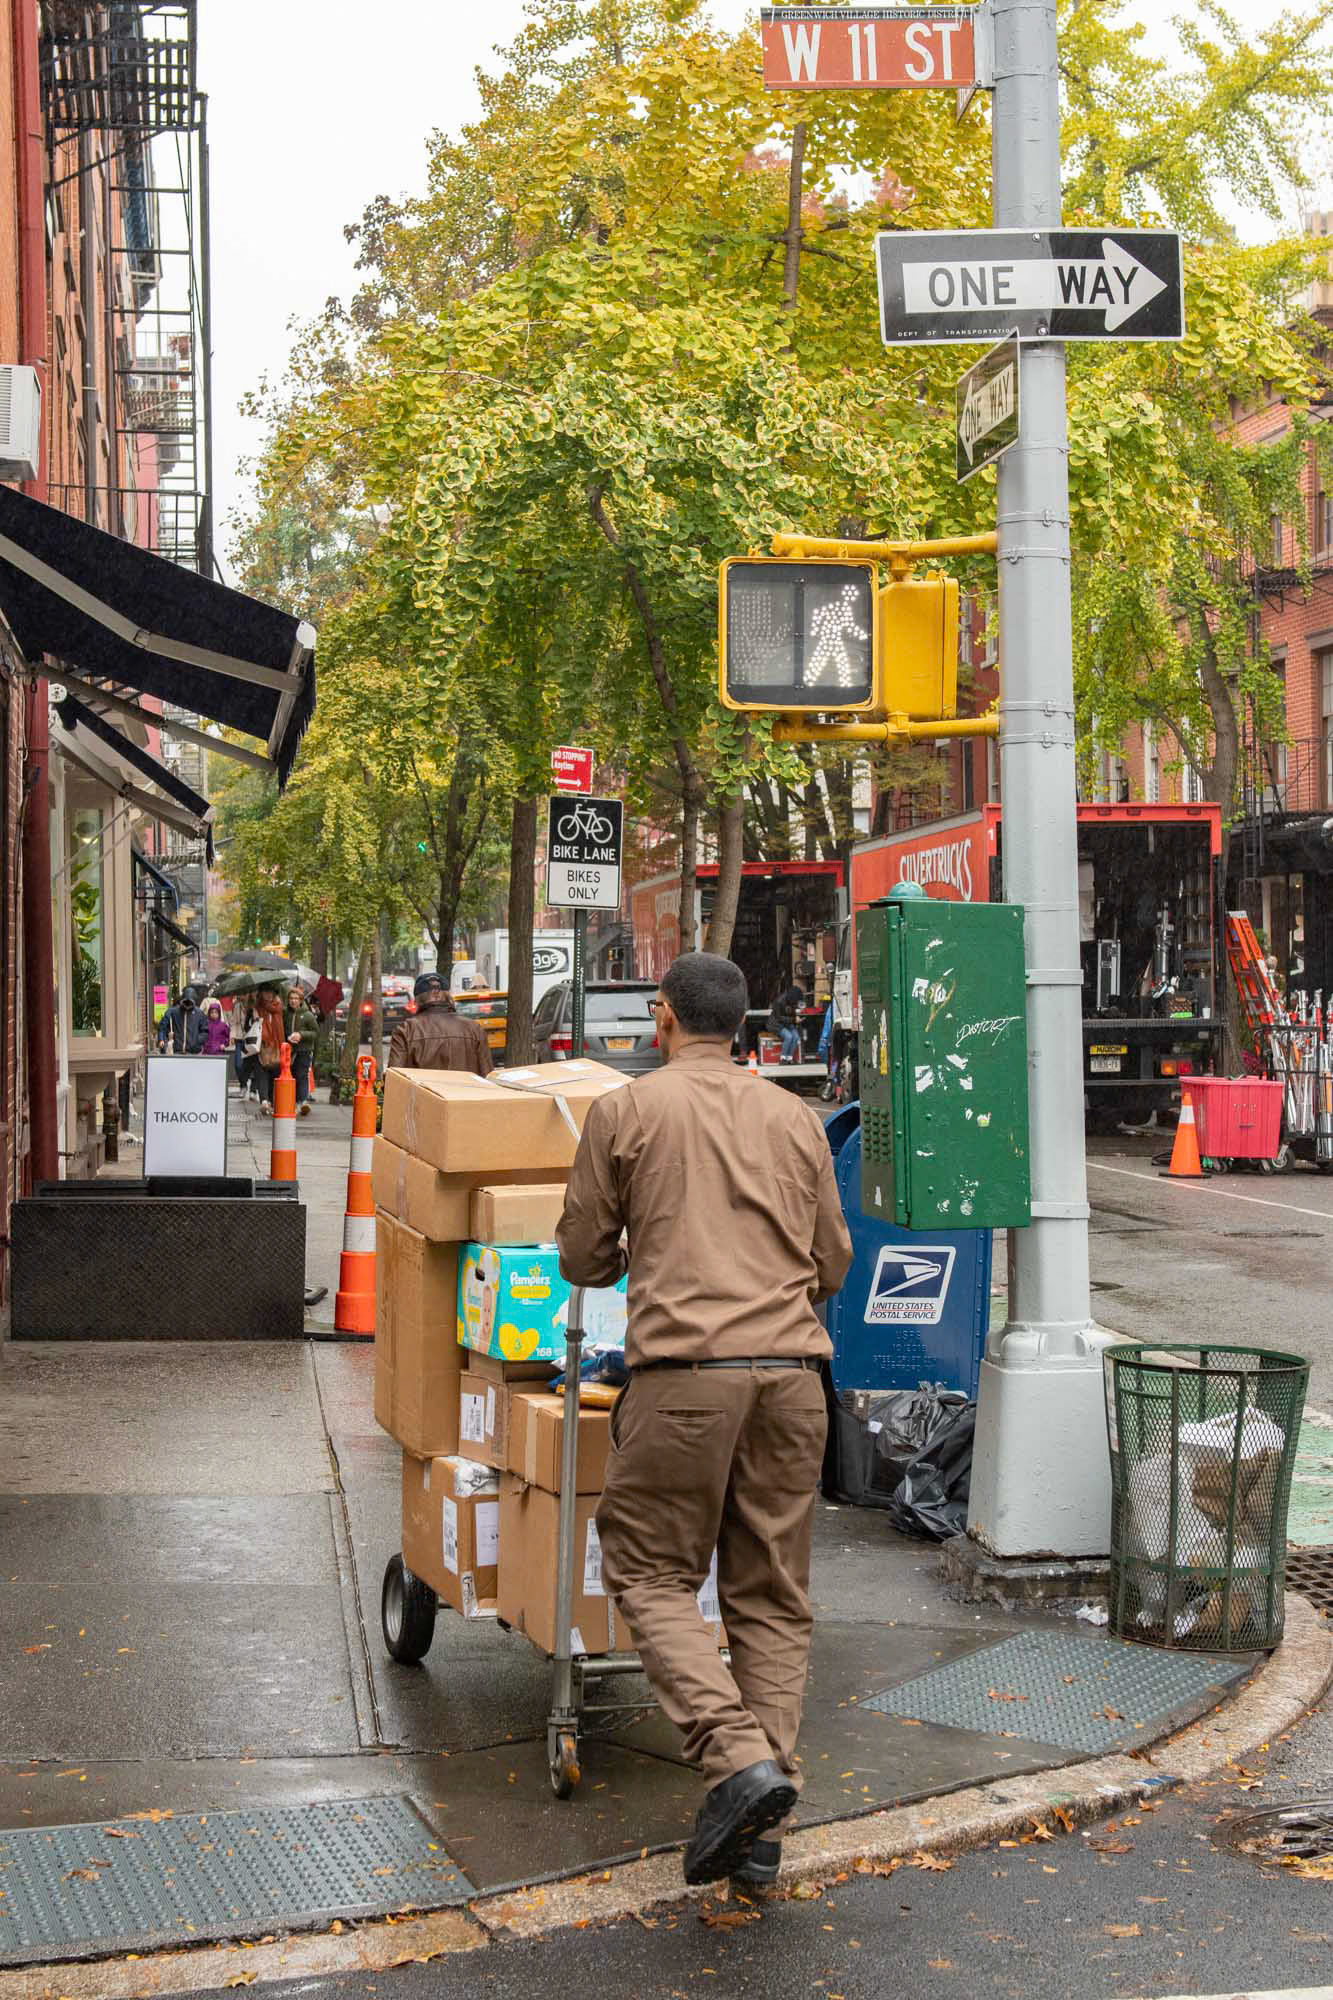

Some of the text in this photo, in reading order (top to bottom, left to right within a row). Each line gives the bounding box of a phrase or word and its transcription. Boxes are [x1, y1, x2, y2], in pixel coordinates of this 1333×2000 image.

[781, 9, 838, 20] GREENWICH
[839, 9, 880, 20] VILLAGE
[882, 9, 923, 20] HISTORIC
[782, 22, 962, 81] W 11 ST
[928, 264, 1139, 308] ONE WAY
[945, 328, 1013, 336] TRANSPORTATIO
[964, 370, 1010, 444] ONE WAY
[562, 752, 587, 763] STOPPING
[553, 844, 617, 862] BIKE LANE
[567, 869, 601, 884] BIKES
[568, 886, 599, 900] ONLY
[532, 952, 559, 970] age
[153, 1111, 218, 1123] THAKOON
[510, 1271, 551, 1287] Pampers
[872, 1302, 934, 1310] UNITED STATES
[870, 1311, 937, 1319] POSTAL SERVICE
